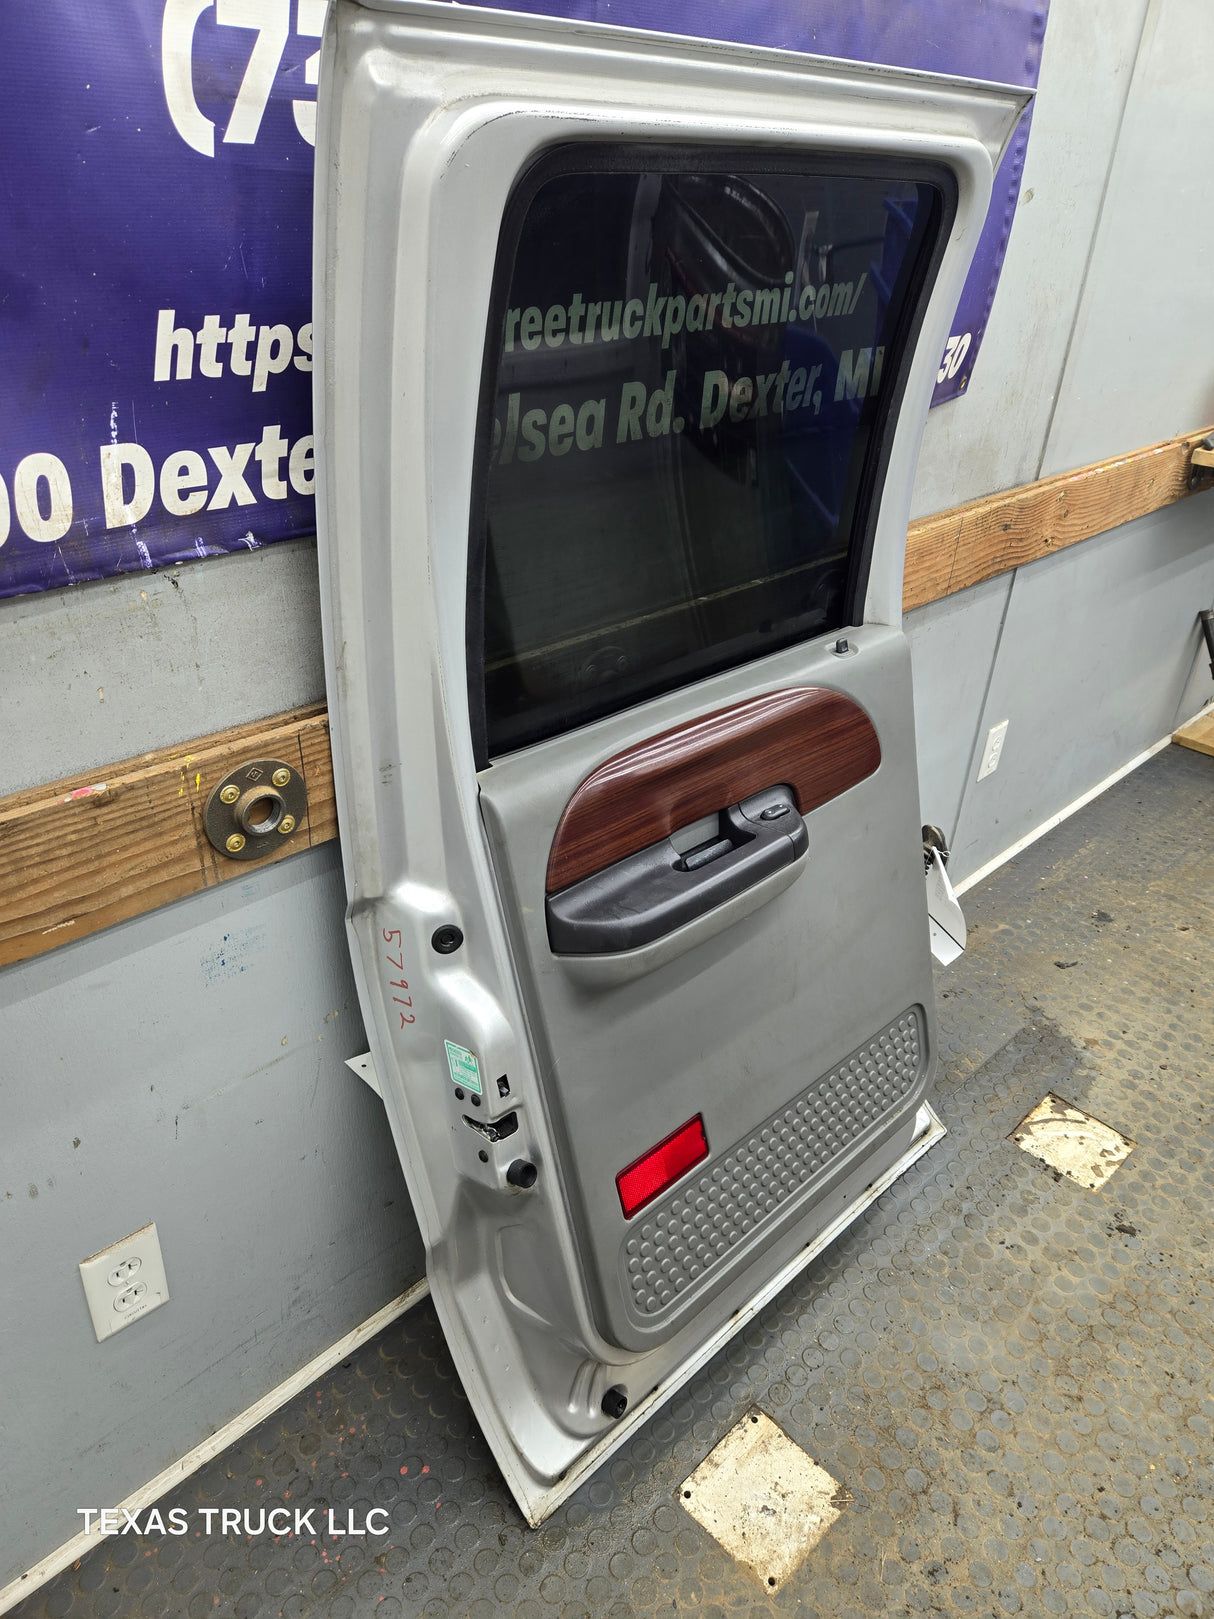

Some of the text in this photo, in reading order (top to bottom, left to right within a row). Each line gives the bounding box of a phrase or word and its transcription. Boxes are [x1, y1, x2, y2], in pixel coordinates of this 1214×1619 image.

[616, 370, 686, 438] Rd.
[699, 359, 823, 430] Dexter,
[833, 346, 885, 402] MI
[383, 927, 416, 1029] 57972
